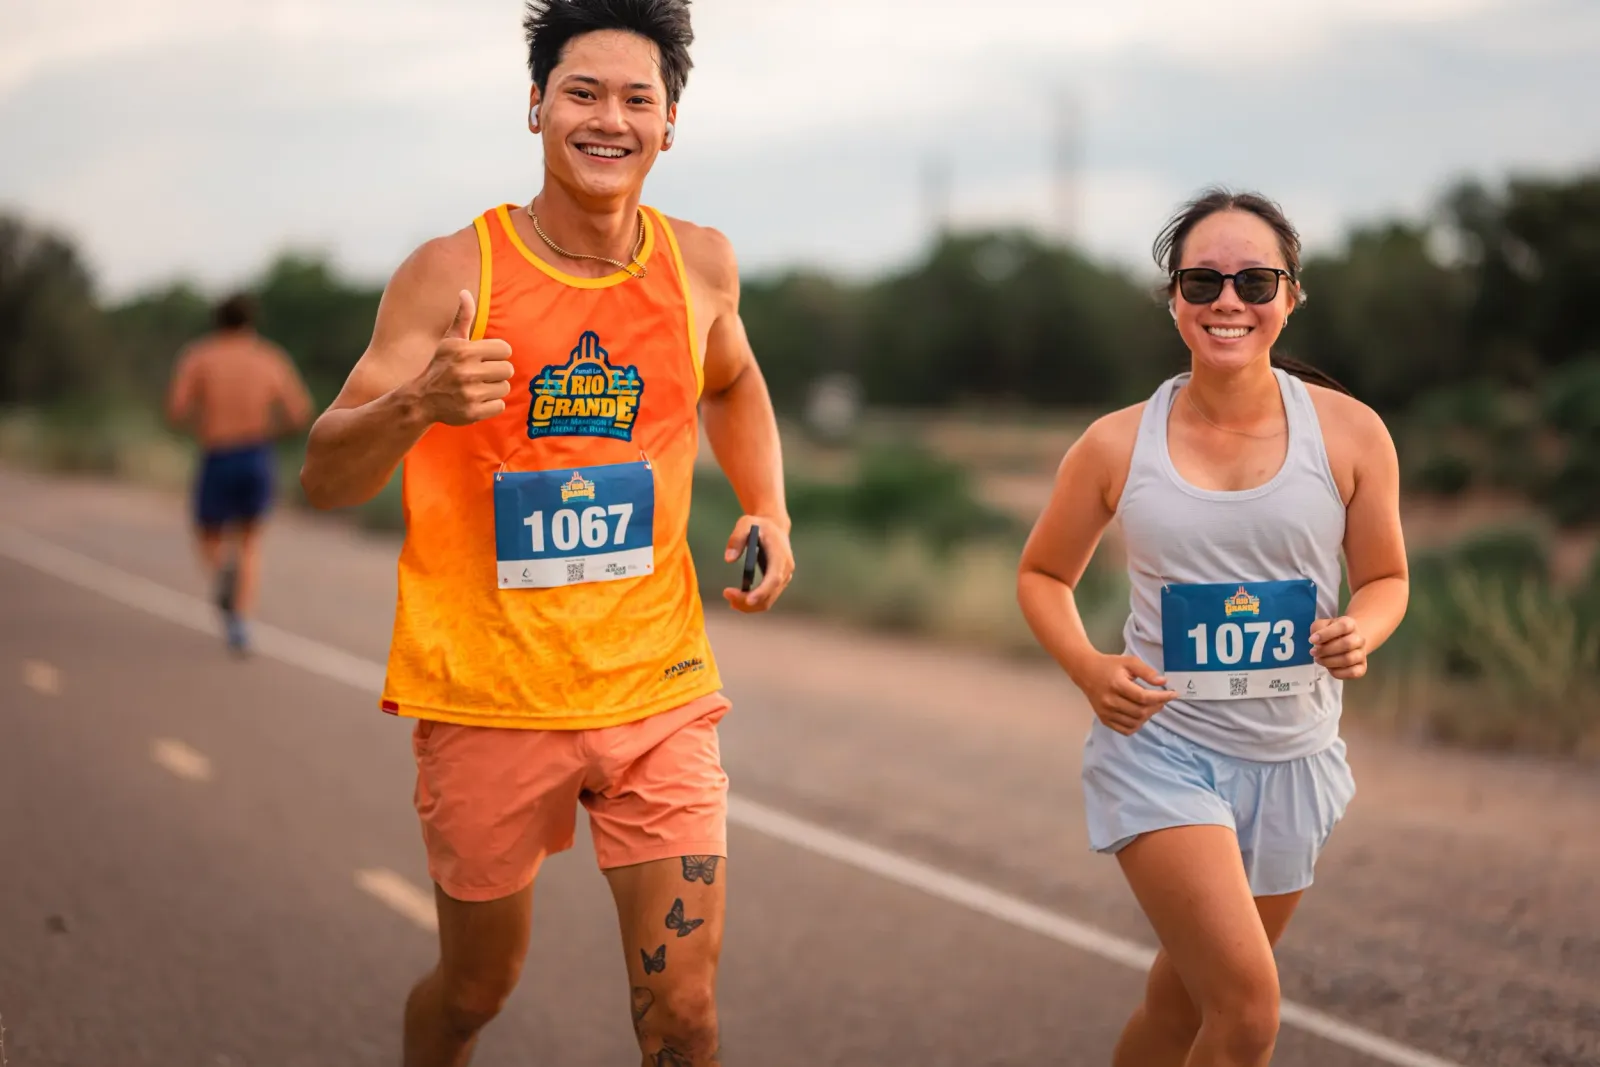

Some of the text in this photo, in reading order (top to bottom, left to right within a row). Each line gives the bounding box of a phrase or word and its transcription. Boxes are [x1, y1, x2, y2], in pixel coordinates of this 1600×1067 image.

[570, 375, 605, 395] RIO
[532, 396, 637, 422] GRANDE
[523, 502, 633, 553] 1067
[1187, 619, 1295, 665] 1073
